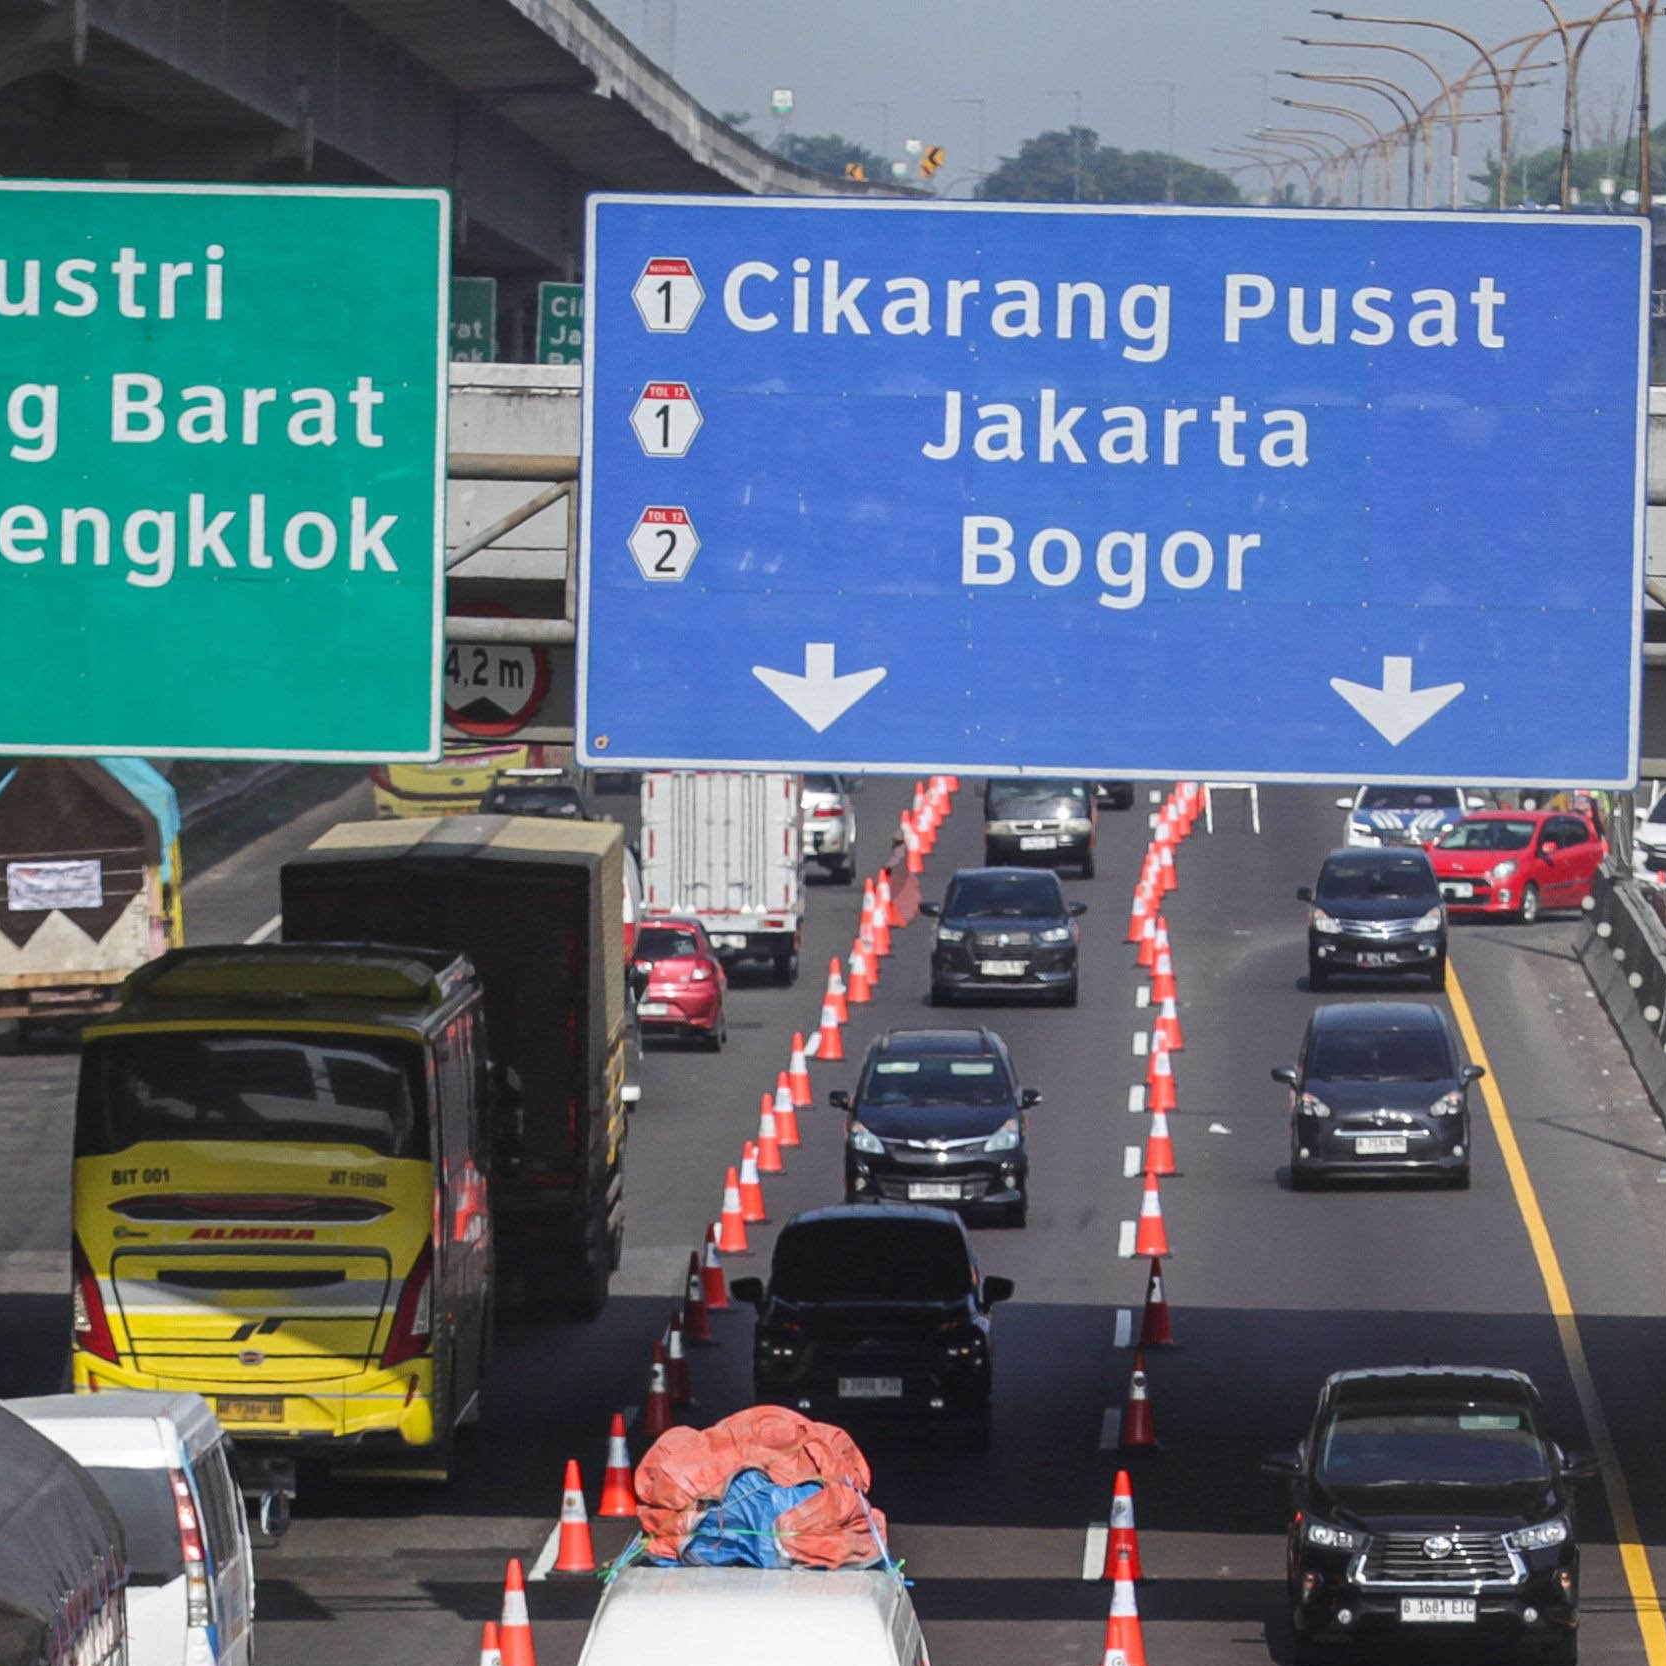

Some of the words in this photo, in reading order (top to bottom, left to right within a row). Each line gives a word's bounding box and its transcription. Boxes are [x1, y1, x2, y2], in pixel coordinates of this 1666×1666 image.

[656, 280, 673, 324] 1
[723, 258, 1173, 362] Cikarang
[1224, 271, 1507, 349] Pusat
[111, 373, 386, 449] Barat
[649, 387, 670, 397] TOL
[654, 404, 671, 448] 1
[922, 388, 1309, 469] Jakarta
[648, 510, 667, 522] TOL
[653, 529, 677, 572] 2
[961, 515, 1262, 610] Bogor
[446, 647, 489, 687] 4,2
[499, 656, 523, 689] m
[111, 1169, 138, 1186] BIT
[142, 1167, 171, 1184] 001
[188, 1228, 317, 1241] ALMIRA
